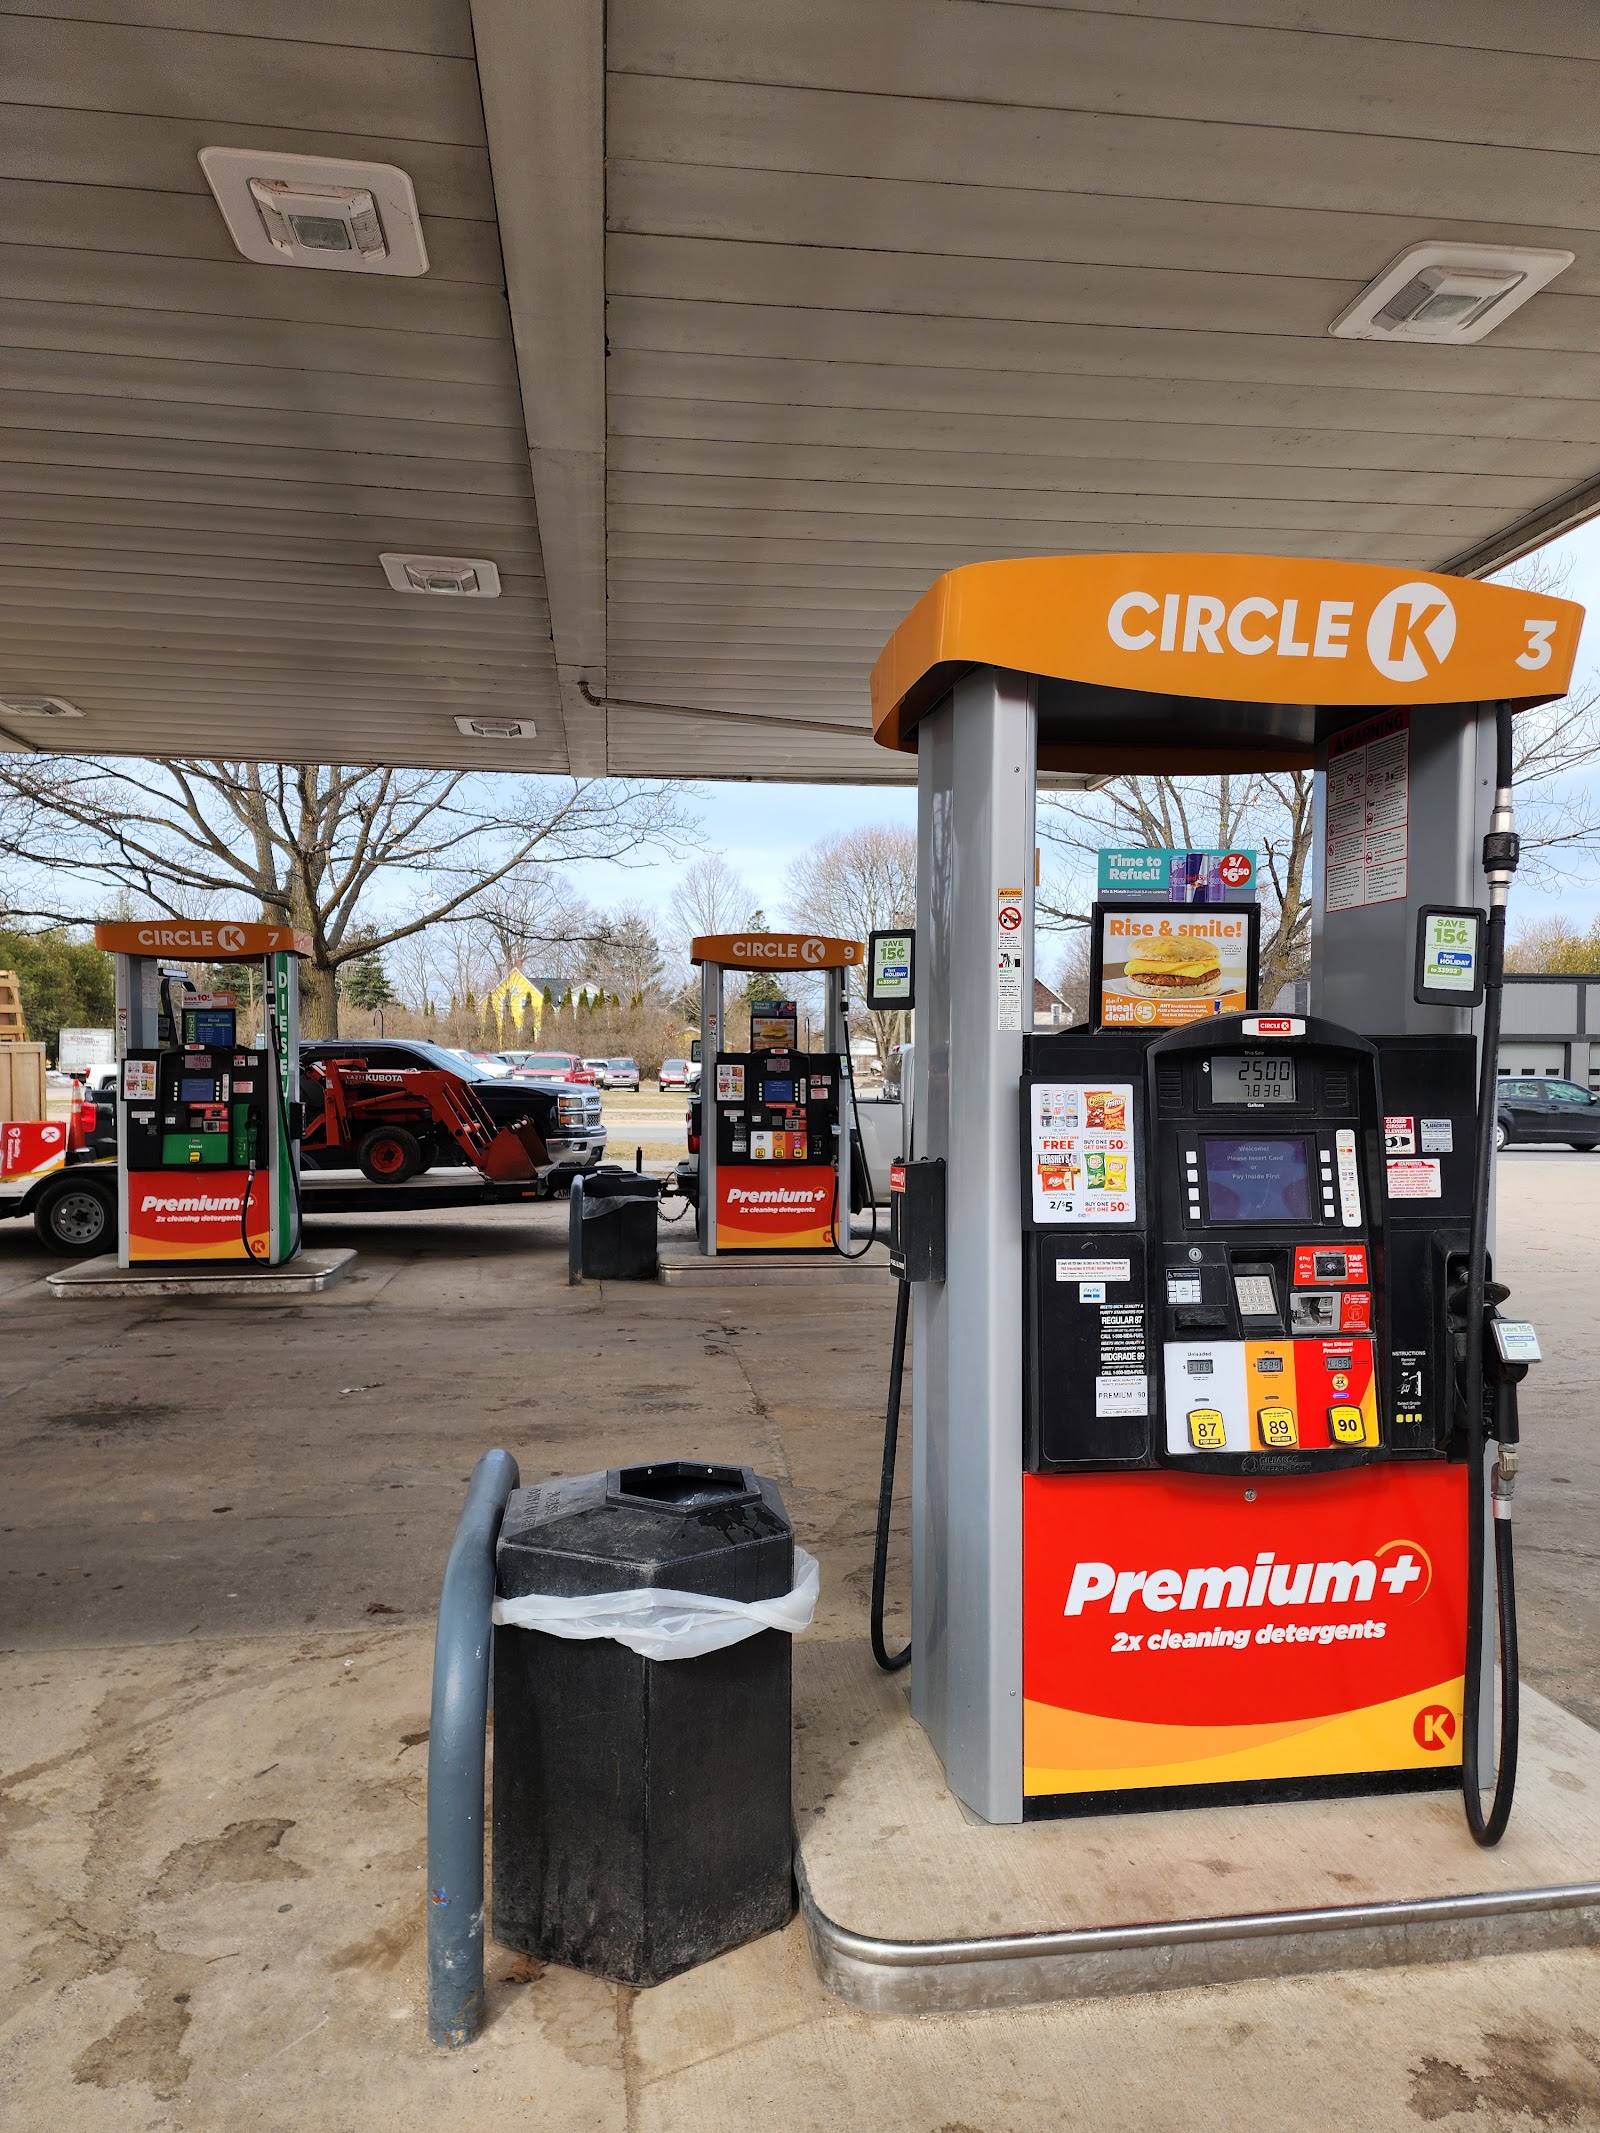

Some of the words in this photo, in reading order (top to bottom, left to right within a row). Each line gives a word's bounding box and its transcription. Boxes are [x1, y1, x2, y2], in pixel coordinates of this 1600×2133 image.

[1107, 591, 1354, 658] CIRCLE
[1515, 620, 1557, 671] 3
[1344, 711, 1404, 746] WARNING
[1108, 854, 1144, 867] Time
[1146, 856, 1162, 867] to
[1228, 856, 1242, 868] 3/
[1110, 868, 1160, 880] Refuel!
[1110, 920, 1154, 937] Rise
[1159, 920, 1172, 937] &
[1178, 920, 1242, 937] smile!
[1437, 920, 1466, 928] SAVE
[138, 930, 214, 946] CIRCLE
[268, 932, 280, 946] 7
[1434, 928, 1468, 944] 15¢
[732, 942, 797, 958] CIRCLE
[844, 947, 854, 959] 9
[880, 948, 905, 960] 15¢
[1105, 1003, 1134, 1012] meal
[1137, 1006, 1152, 1019] $5
[1105, 1012, 1134, 1021] deal!
[1203, 1062, 1210, 1073] $
[1239, 1061, 1290, 1081] 25.00
[366, 1074, 403, 1082] KUBOTA
[1244, 1085, 1280, 1097] 7.838
[1043, 1140, 1074, 1149] FREE
[727, 1188, 825, 1203] Premium+
[141, 1195, 254, 1212] Premium+
[1050, 1201, 1073, 1212] 2/$5
[1102, 1316, 1134, 1324] REGULAR
[1101, 1352, 1136, 1361] MIDGRADE
[1137, 1352, 1145, 1360] 89
[1189, 1363, 1210, 1371] 3.189
[1198, 1423, 1217, 1437] 87
[1269, 1420, 1288, 1434] 89
[1338, 1419, 1357, 1432] 90
[1064, 1552, 1421, 1617] Premium+
[1110, 1632, 1143, 1652] 2x
[1147, 1626, 1251, 1650] cleaning
[1255, 1619, 1387, 1646] detergents
